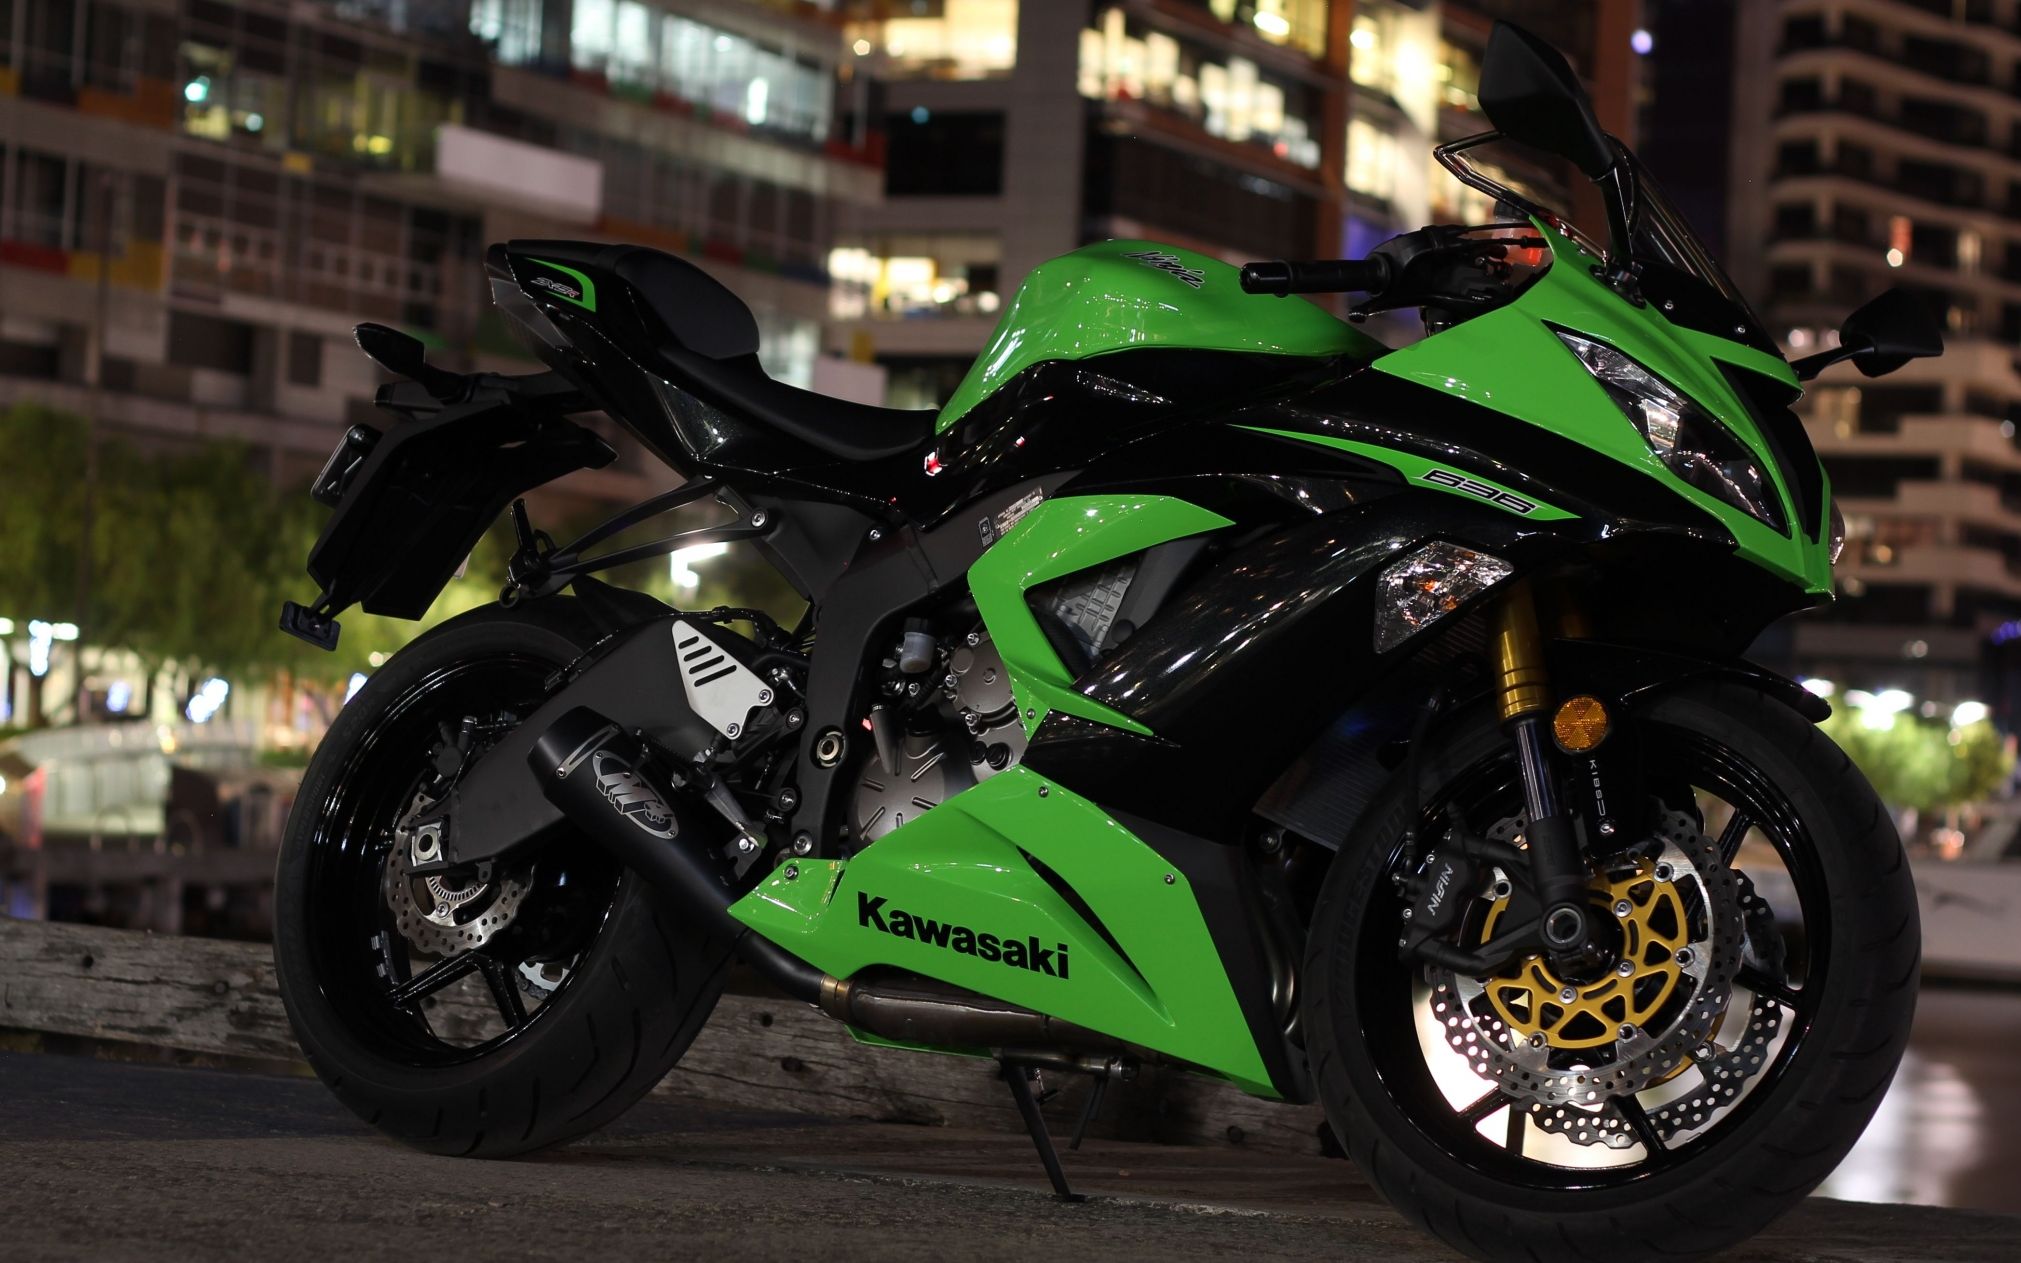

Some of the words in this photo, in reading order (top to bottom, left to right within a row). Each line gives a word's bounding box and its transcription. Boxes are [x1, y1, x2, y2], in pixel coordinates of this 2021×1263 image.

[1121, 251, 1205, 289] Ninja
[1423, 469, 1536, 514] 636
[1427, 862, 1453, 916] NISSIN
[858, 891, 1069, 979] Kawasaki
